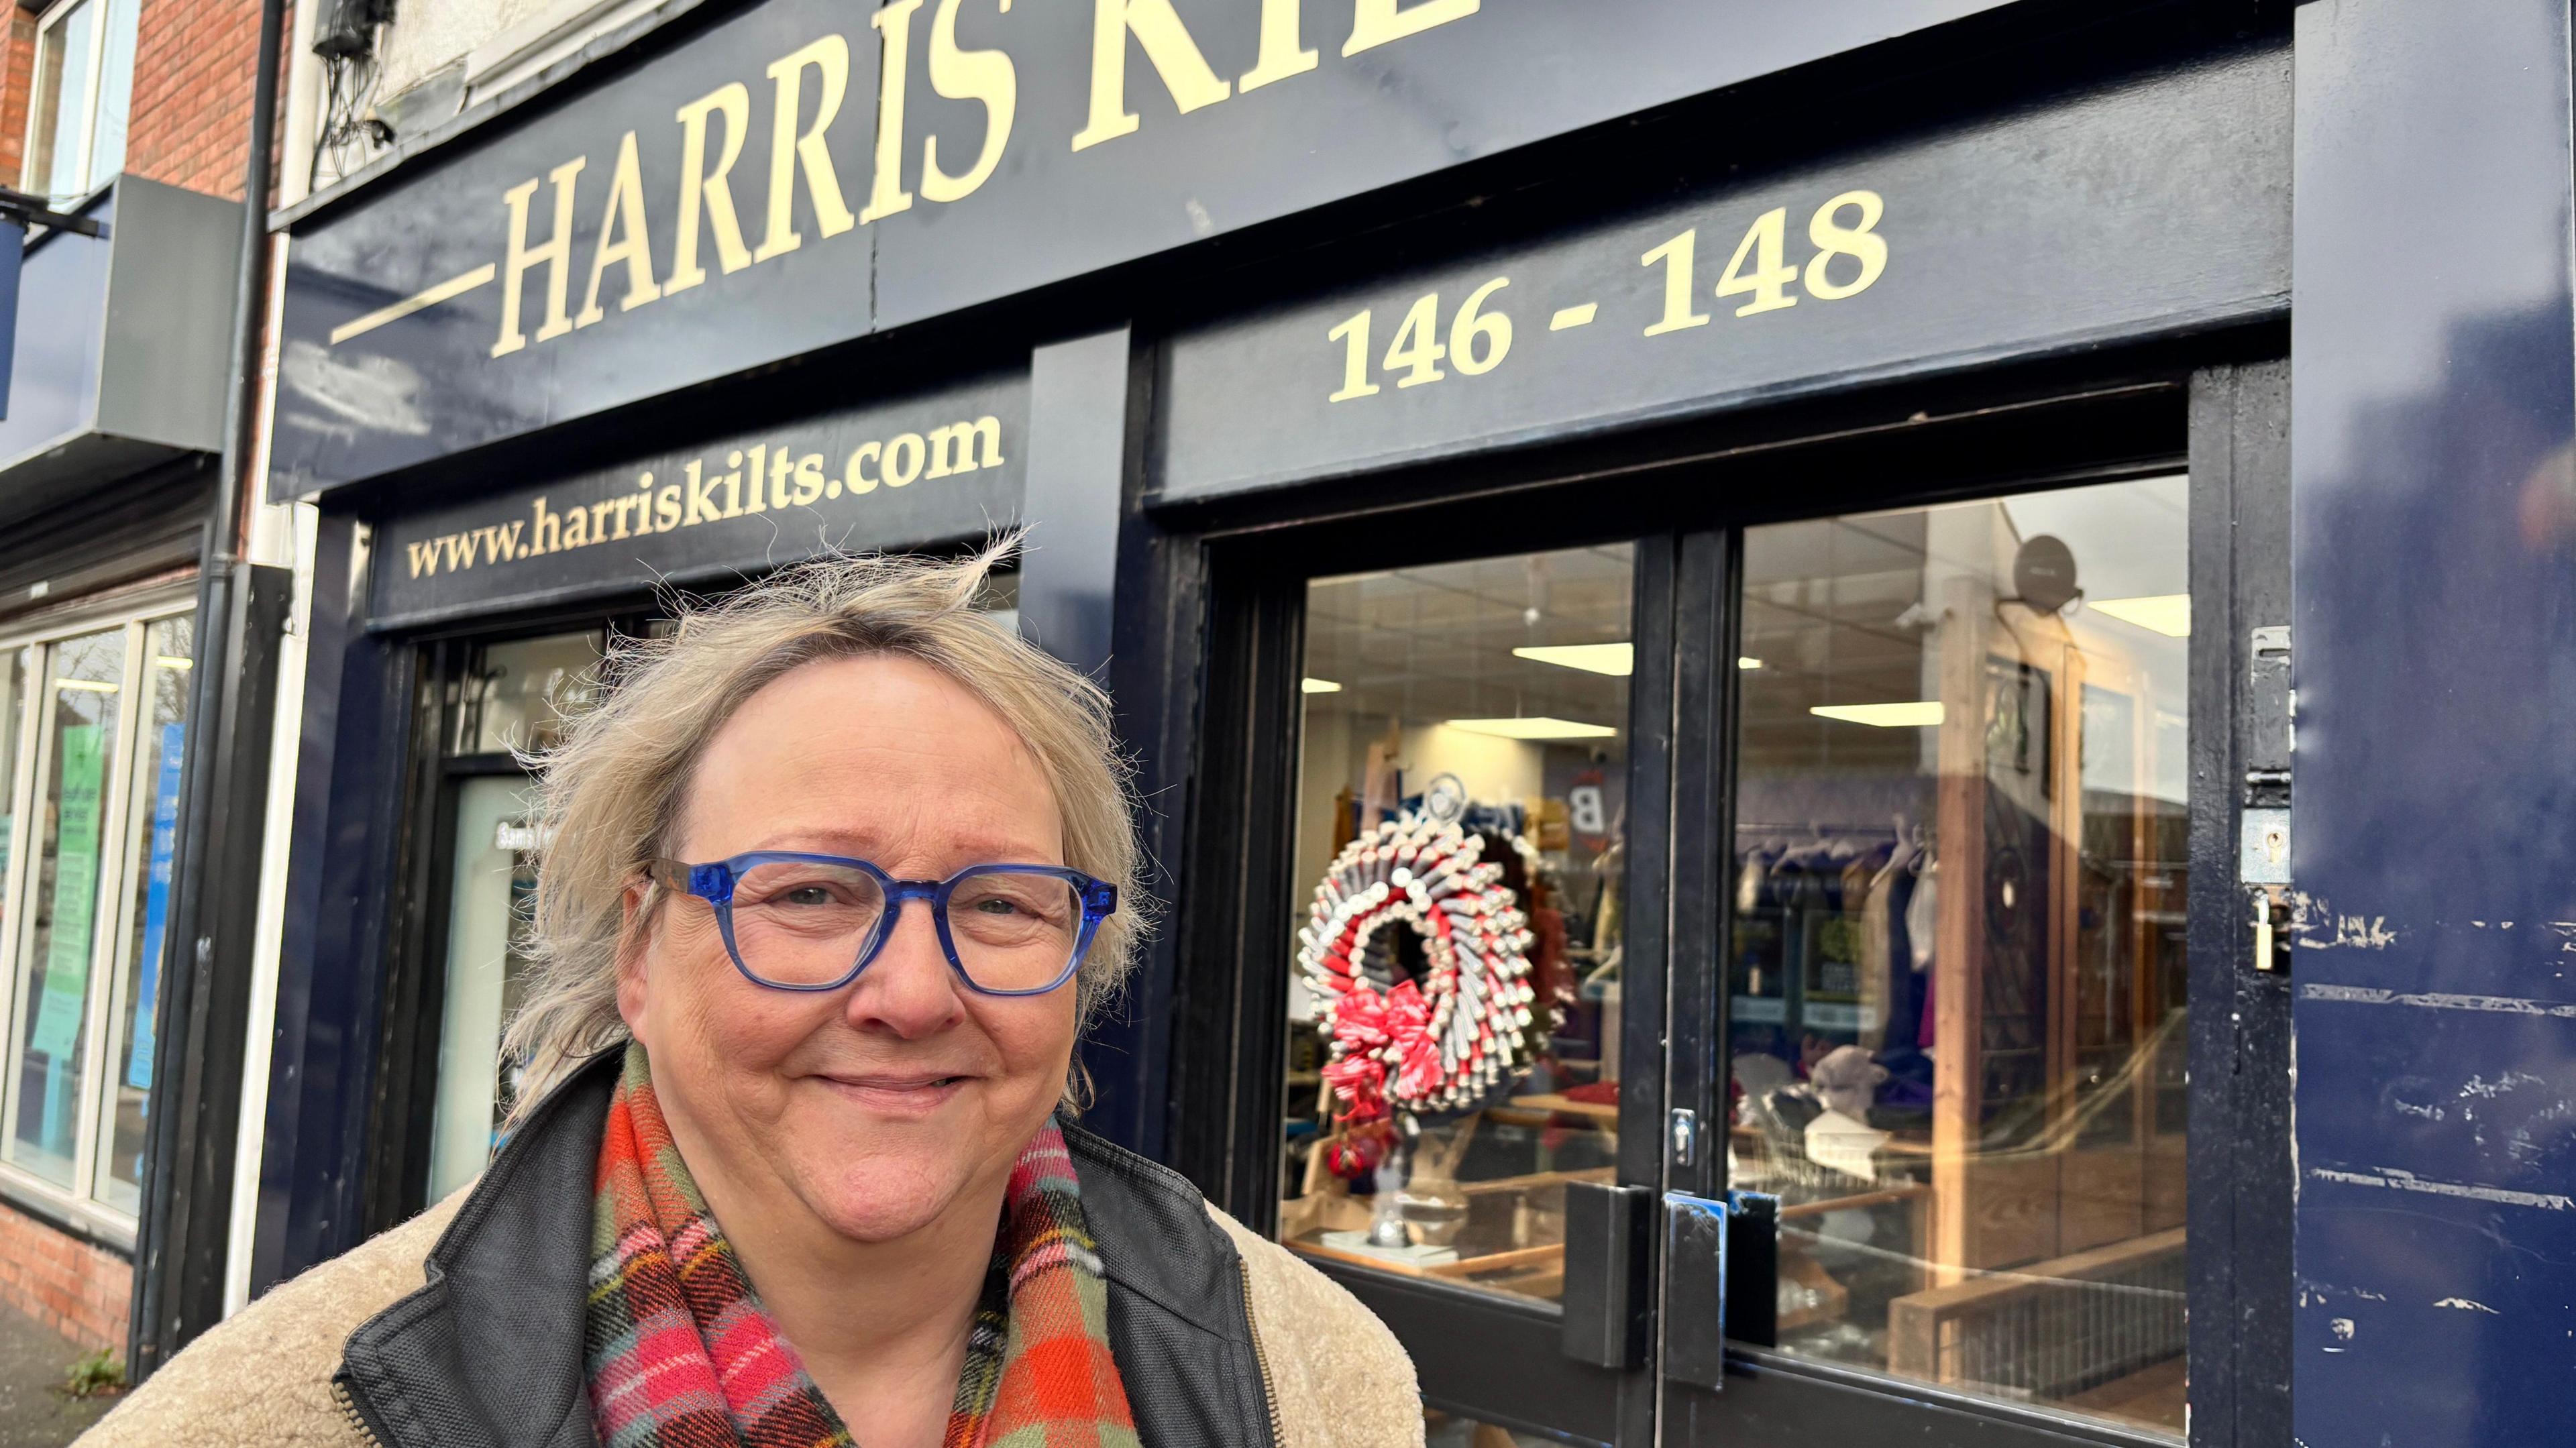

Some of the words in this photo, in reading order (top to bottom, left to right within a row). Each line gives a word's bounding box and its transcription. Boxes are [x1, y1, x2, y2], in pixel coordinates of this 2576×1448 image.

[491, 0, 1016, 358] HARRIS
[1328, 276, 1513, 402] 146
[1549, 302, 1597, 331] -
[1641, 190, 1888, 337] 148
[407, 415, 1004, 579] www.harriskilts.com
